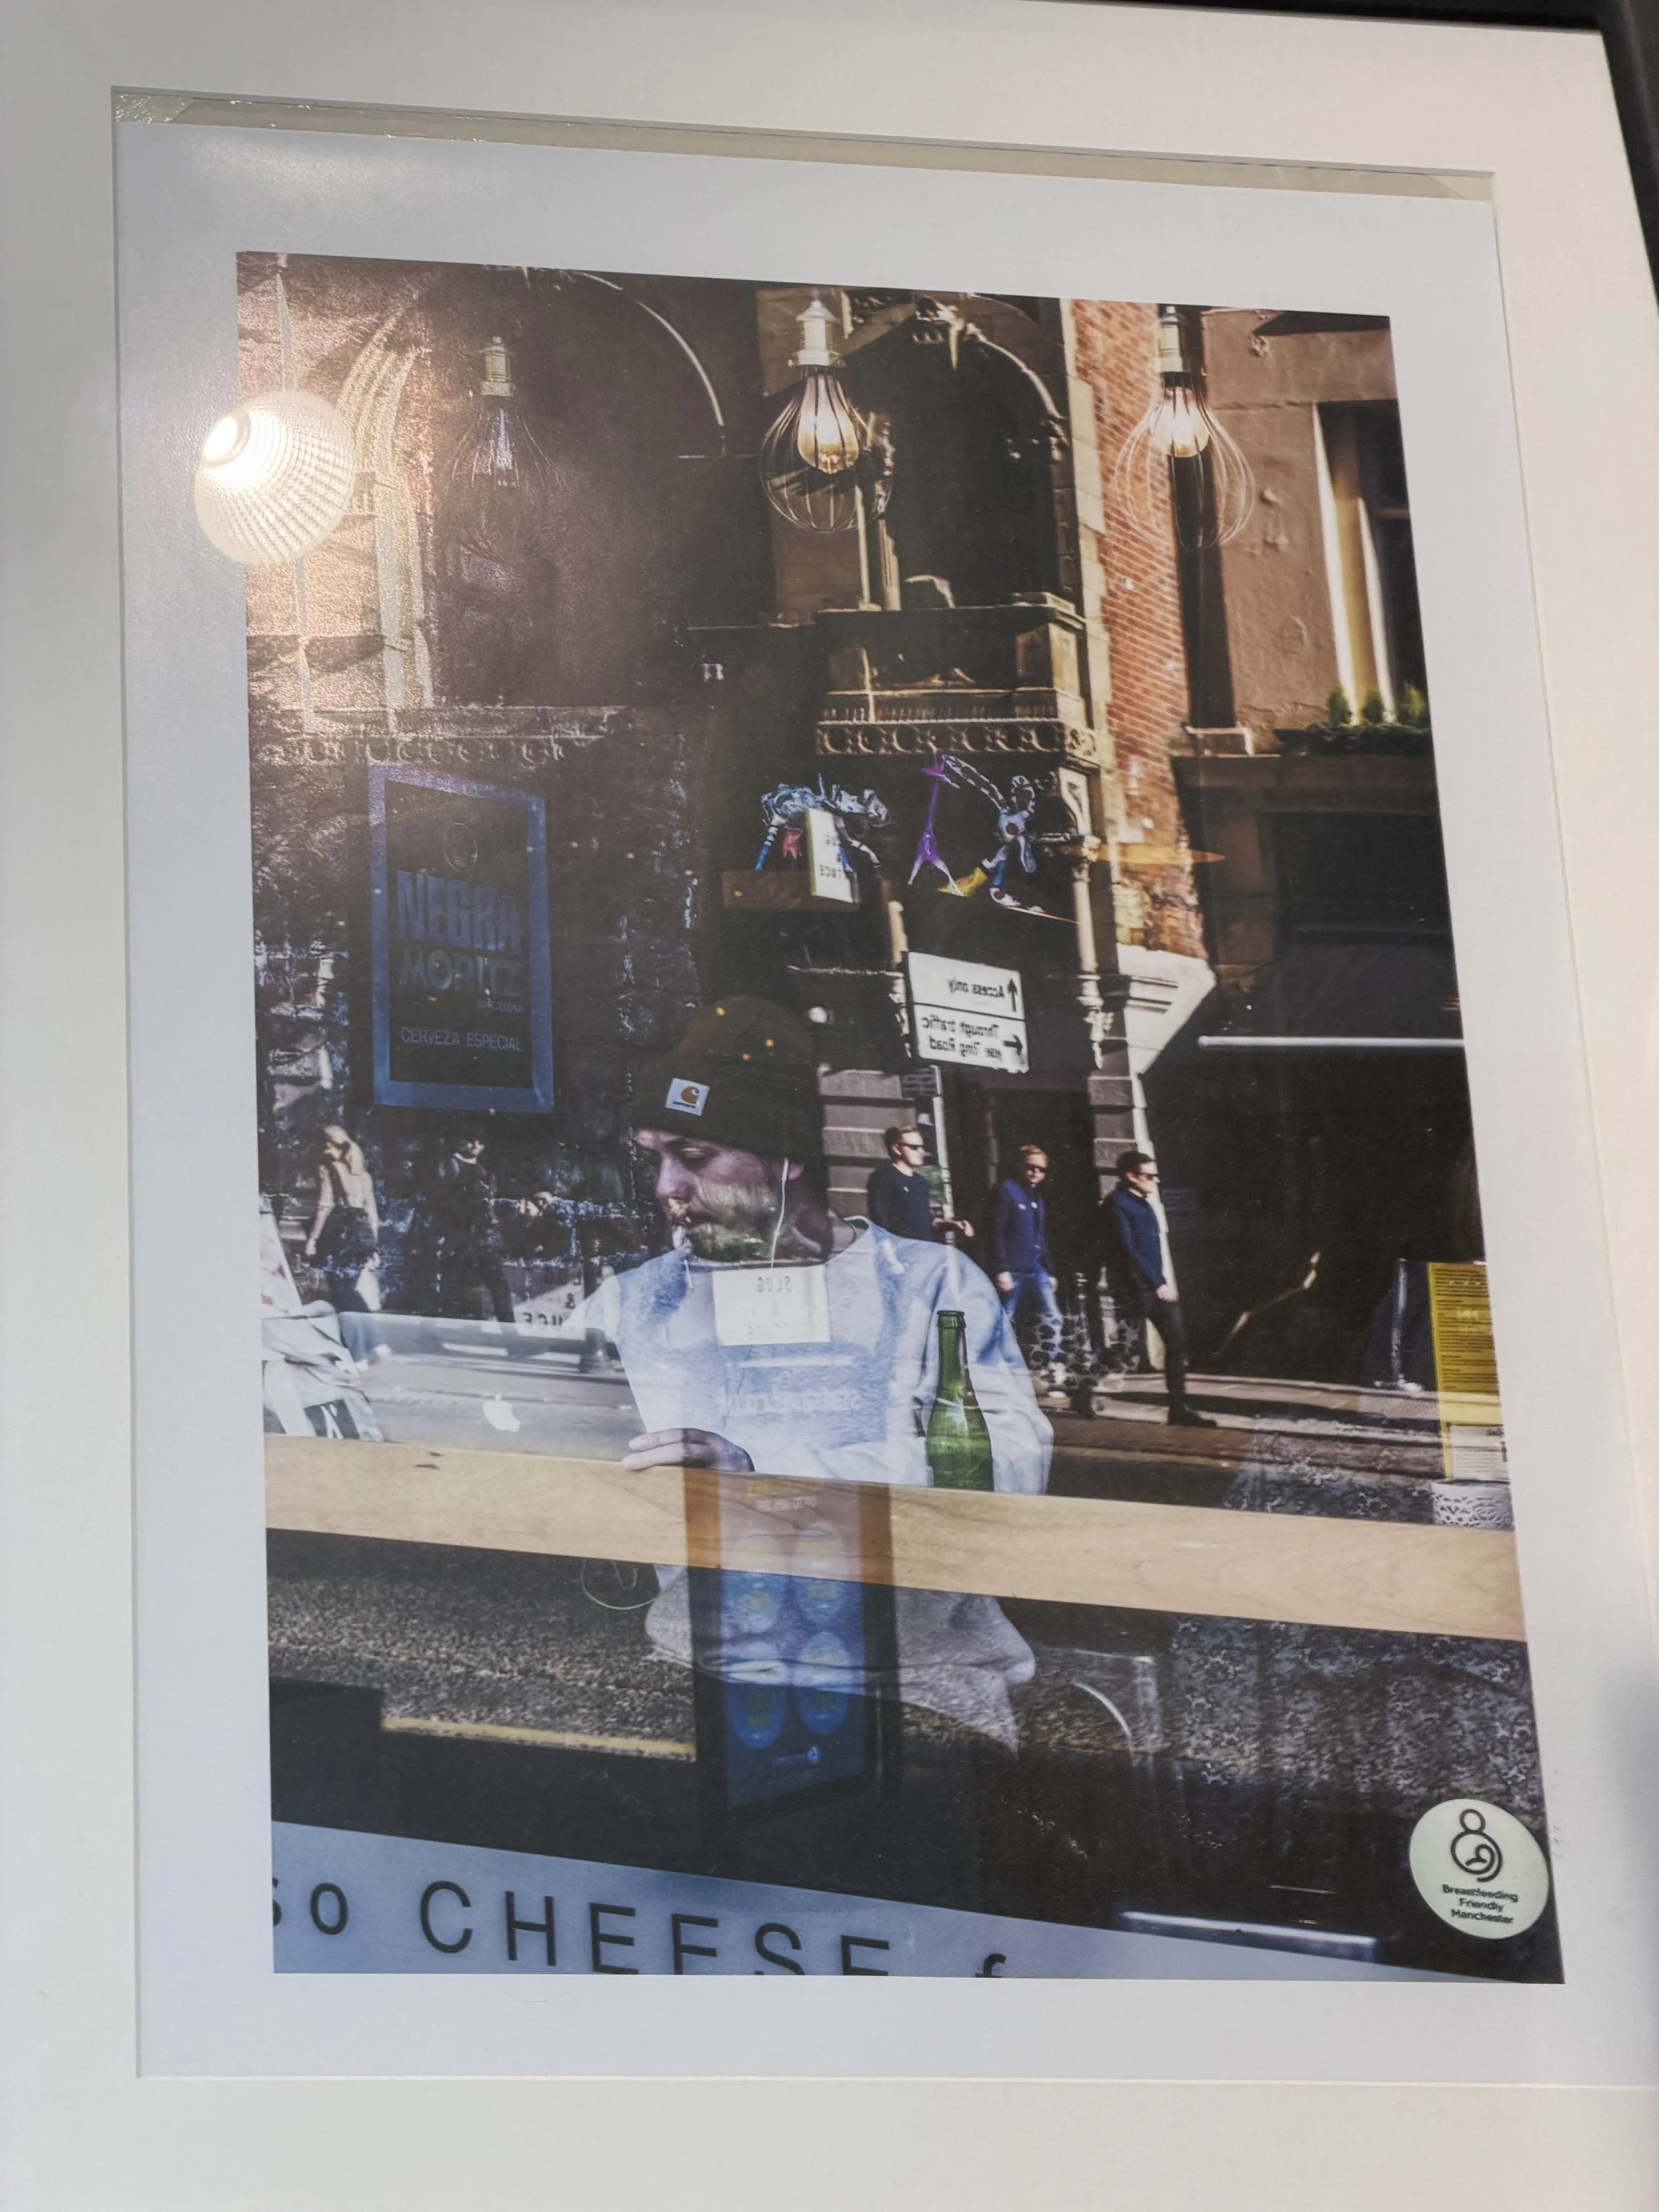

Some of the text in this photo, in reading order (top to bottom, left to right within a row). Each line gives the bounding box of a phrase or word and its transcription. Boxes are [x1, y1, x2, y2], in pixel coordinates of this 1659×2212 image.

[397, 871, 521, 954] NEGRA
[399, 948, 522, 996] MORITZ
[401, 1028, 522, 1051] CERVEZA ESPECIAL
[1442, 1884, 1519, 1902] Breastfeeding
[1459, 1898, 1504, 1913] Friendly
[1451, 1909, 1514, 1924] Manchester
